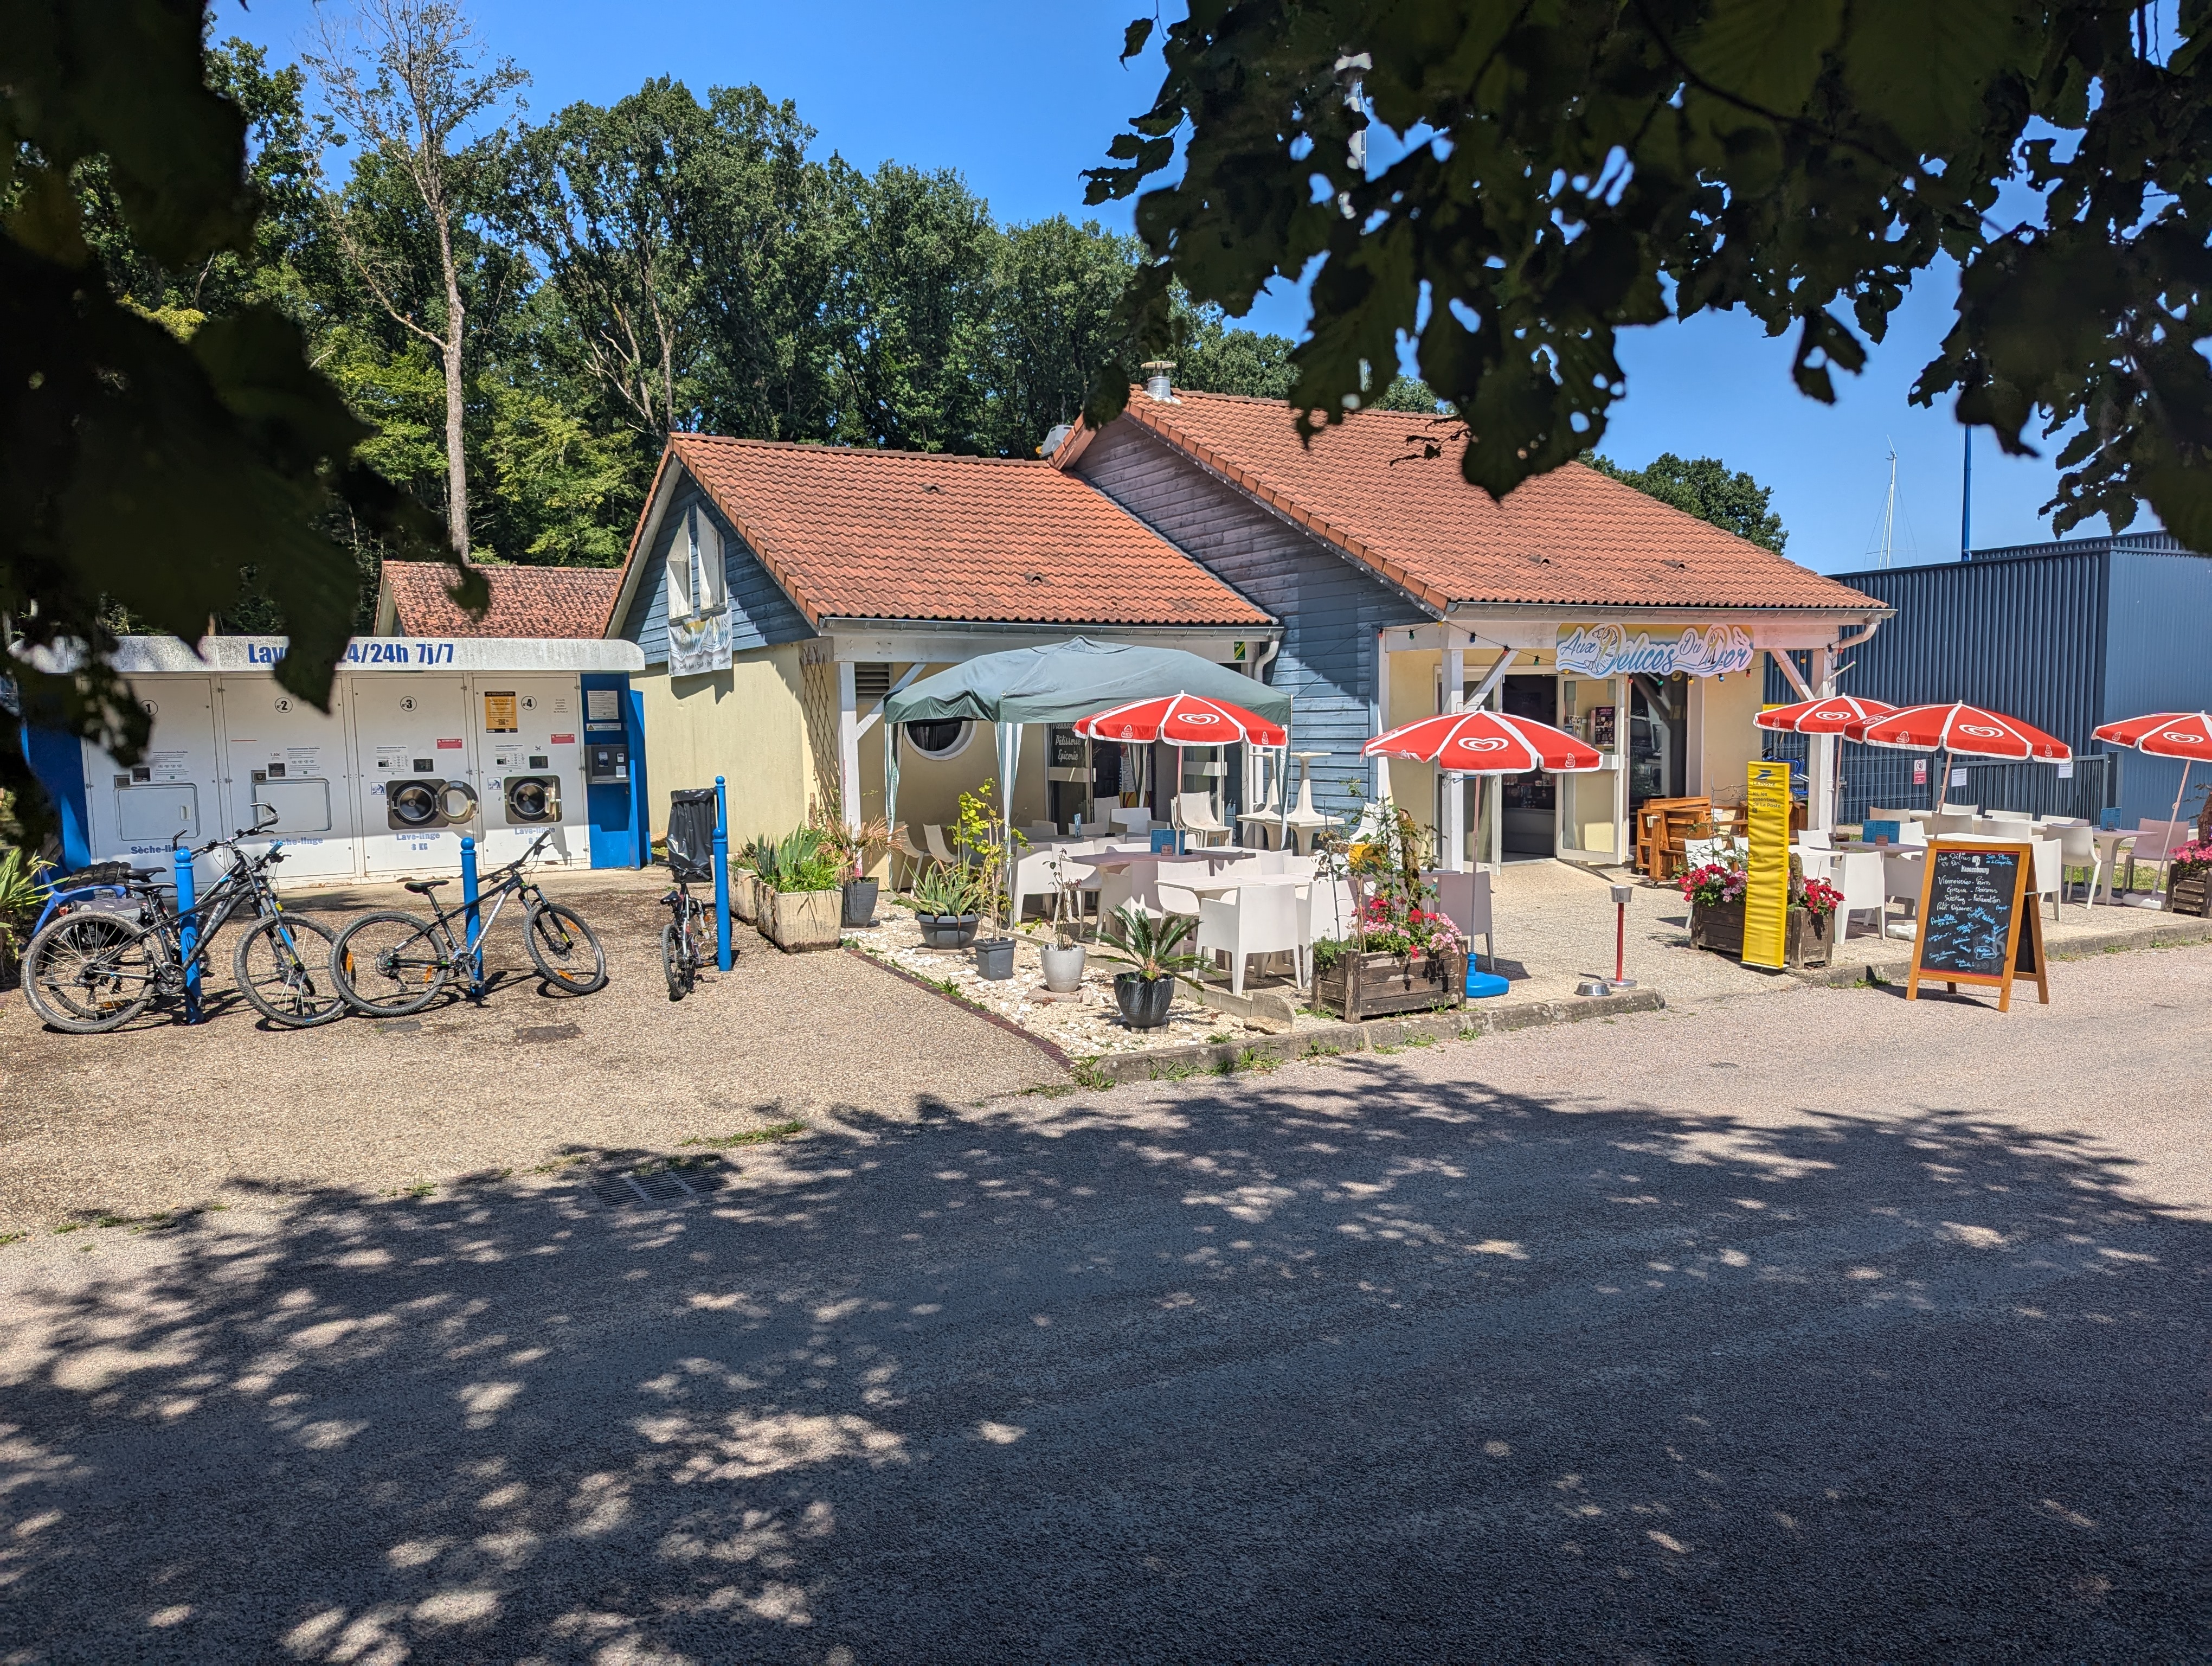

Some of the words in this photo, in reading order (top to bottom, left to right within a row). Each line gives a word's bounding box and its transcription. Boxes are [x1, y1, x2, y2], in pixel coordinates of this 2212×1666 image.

[248, 643, 288, 664] Lav
[416, 644, 454, 665] 7j/7
[1560, 631, 1597, 656] Aux
[1596, 624, 1679, 676] Délices
[1680, 631, 1703, 656] Du
[1696, 626, 1753, 673] Der
[1054, 735, 1081, 746] Pâtisserie
[396, 832, 441, 841] Lave-linge
[1960, 864, 1990, 875] Kronenbourg
